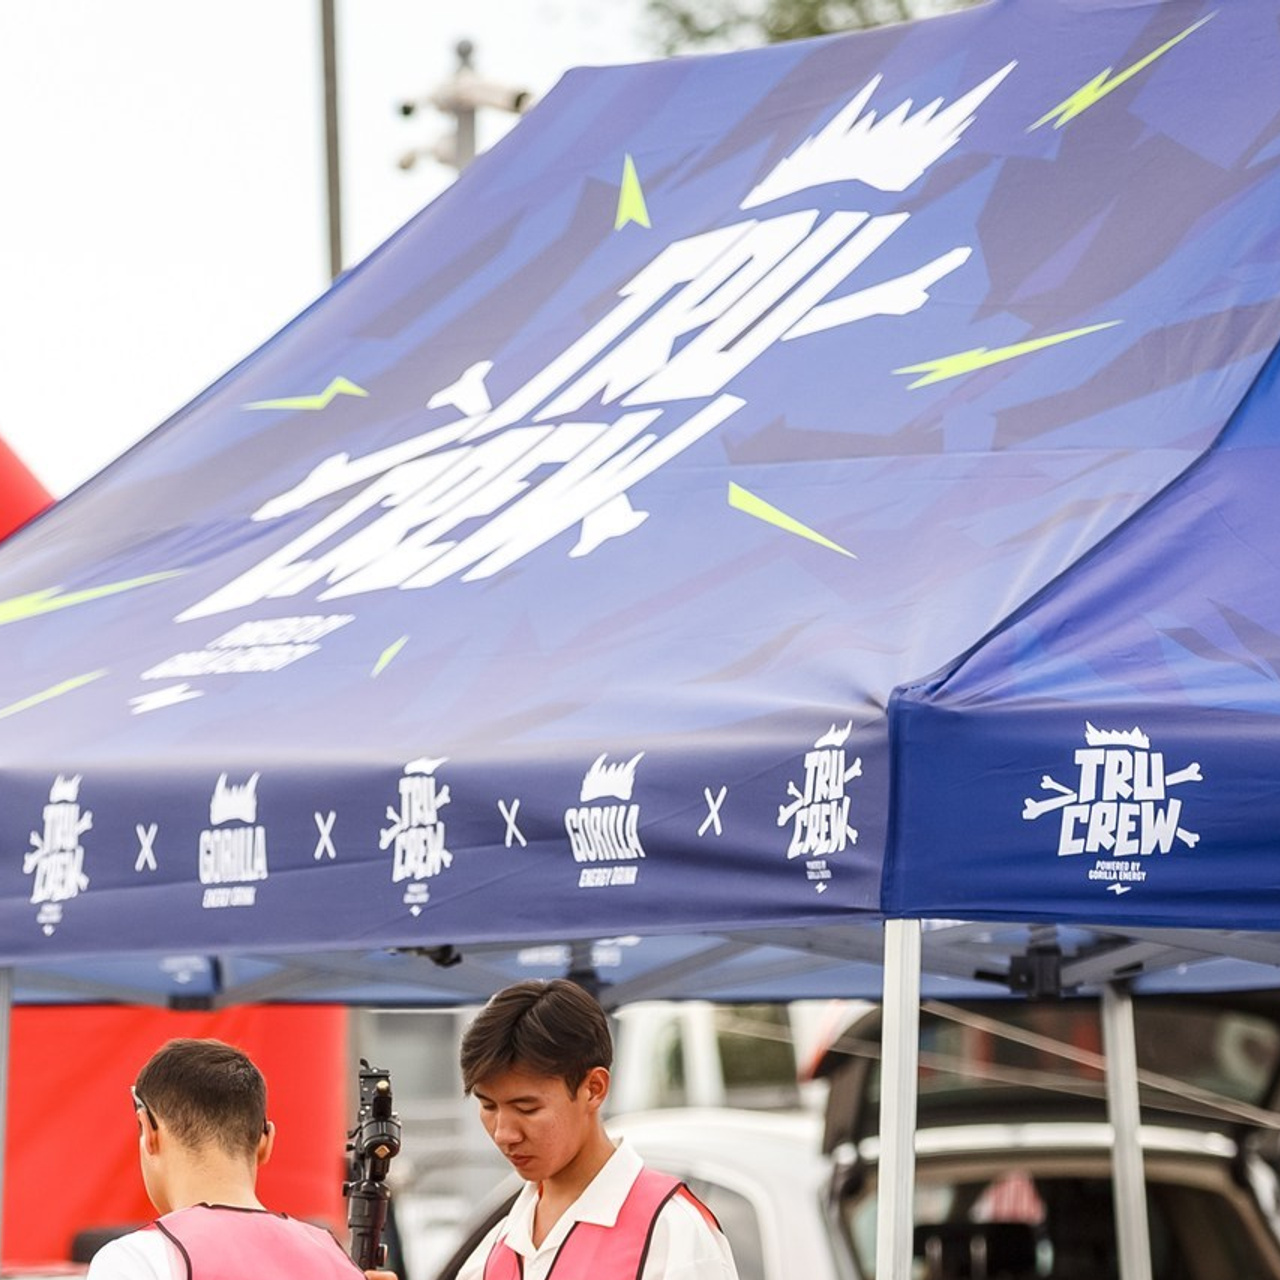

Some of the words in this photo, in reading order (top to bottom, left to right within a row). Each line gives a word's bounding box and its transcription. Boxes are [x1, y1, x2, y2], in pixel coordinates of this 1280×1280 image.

[460, 208, 910, 442] TRU
[173, 392, 747, 622] CREW
[804, 750, 845, 806] TRU
[1074, 749, 1165, 803] TRU
[564, 804, 646, 863] GORILLA
[787, 796, 850, 859] CREW
[1058, 798, 1182, 856] CREW
[1088, 869, 1118, 880] GORILLA
[1119, 871, 1147, 881] ENERGY
[1096, 860, 1130, 871] POWERED
